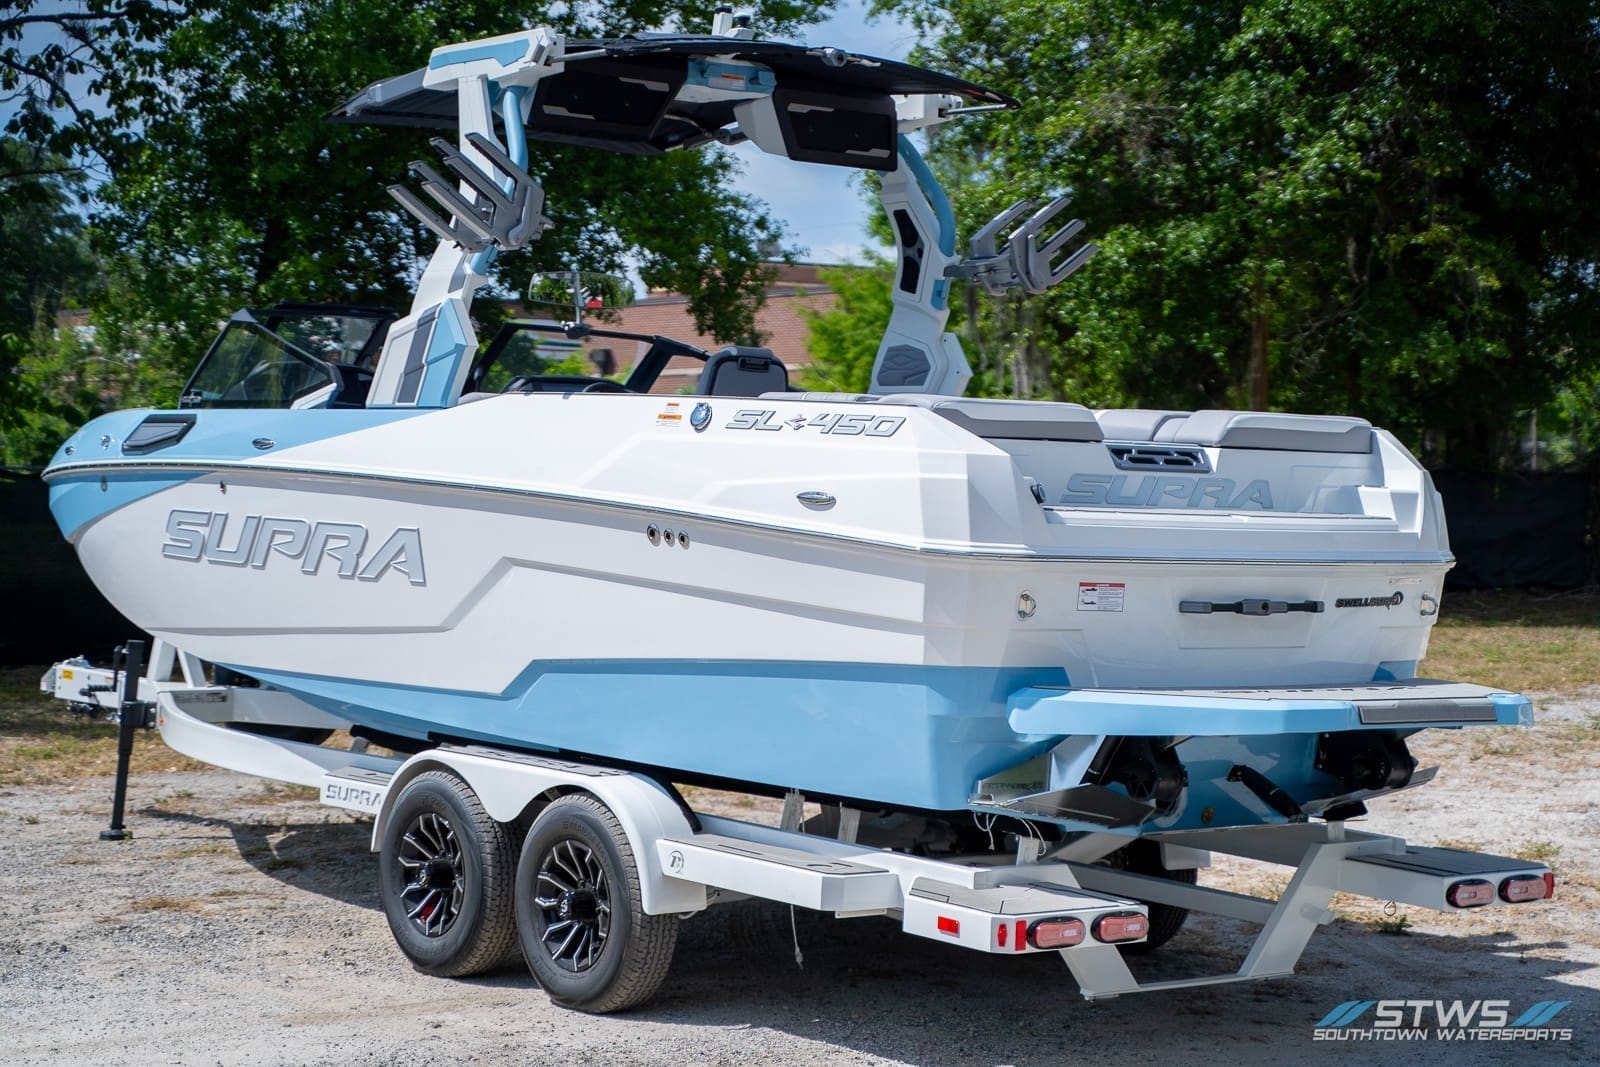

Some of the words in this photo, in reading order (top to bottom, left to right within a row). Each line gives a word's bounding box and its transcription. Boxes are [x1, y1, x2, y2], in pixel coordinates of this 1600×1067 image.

[725, 409, 784, 432] SL
[807, 413, 907, 437] 450
[1060, 473, 1275, 509] SUPRA
[162, 509, 427, 587] SUPRA
